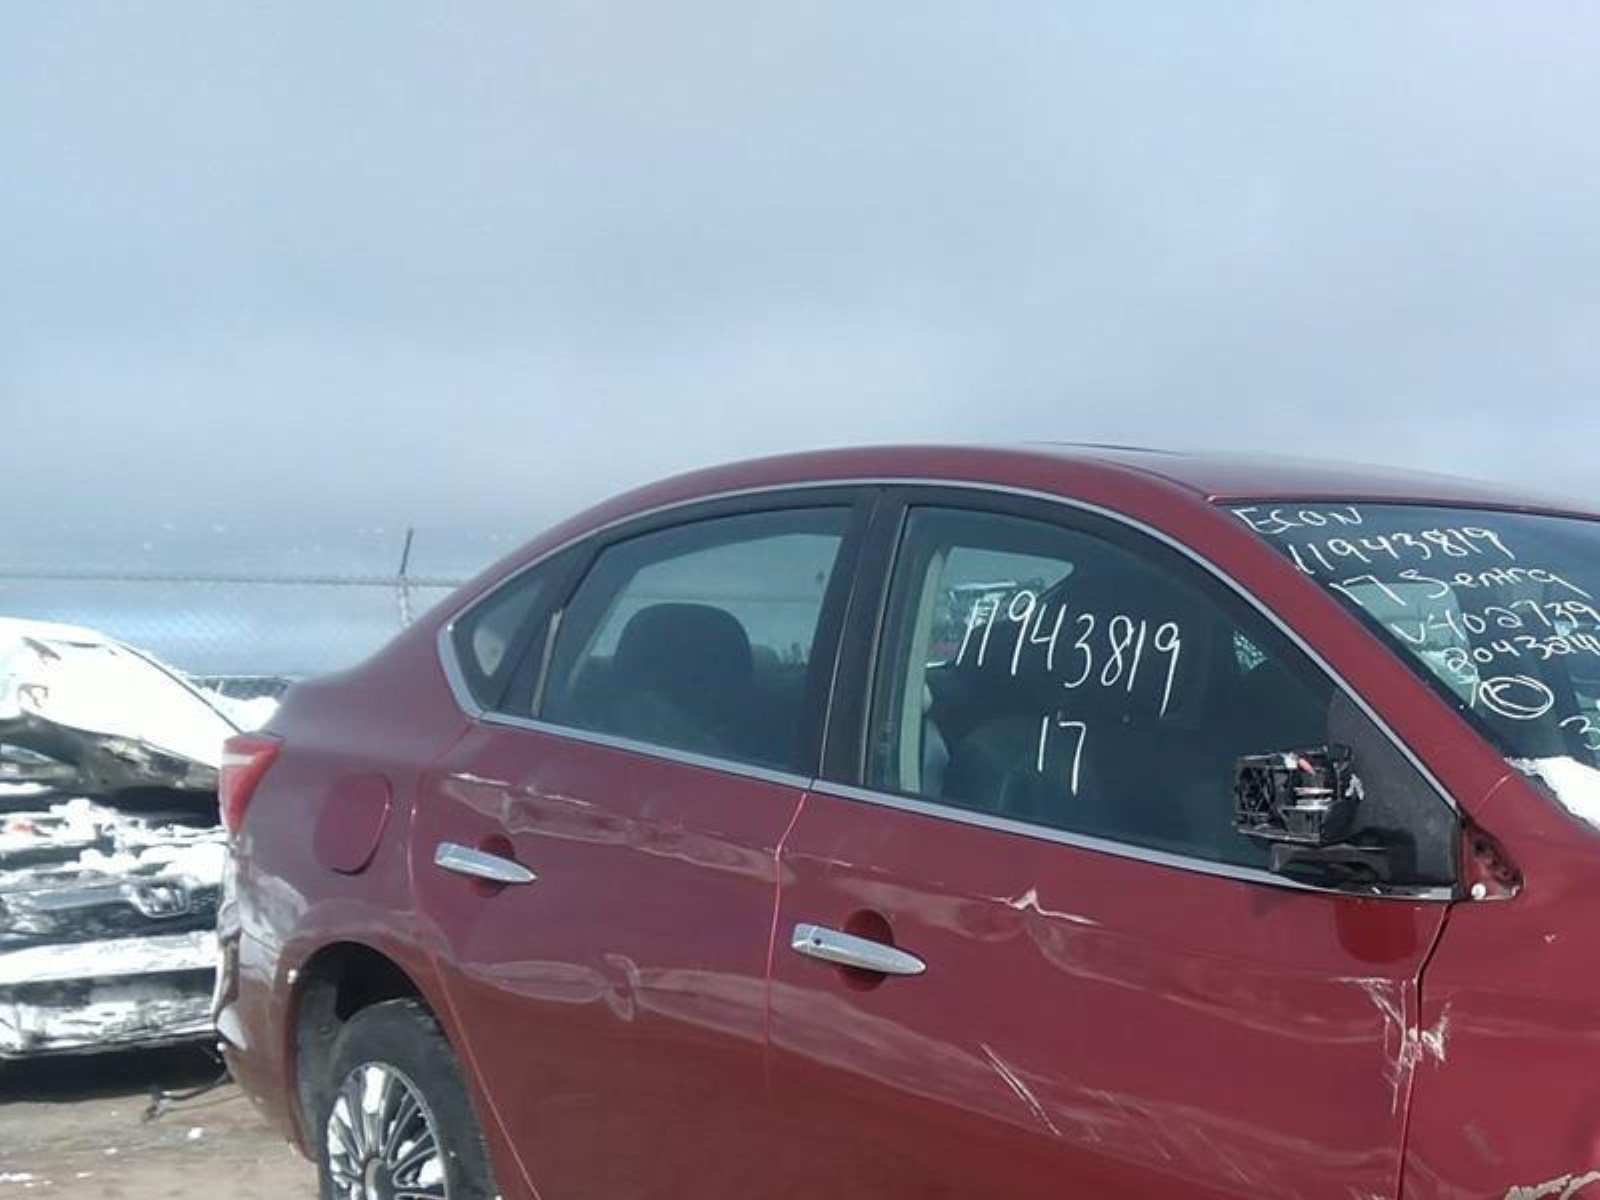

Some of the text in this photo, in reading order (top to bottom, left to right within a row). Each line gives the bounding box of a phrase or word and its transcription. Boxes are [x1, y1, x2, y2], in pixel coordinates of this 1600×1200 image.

[1288, 526, 1516, 575] 11943819
[955, 589, 1181, 717] 11943819
[1036, 715, 1087, 797] 17
